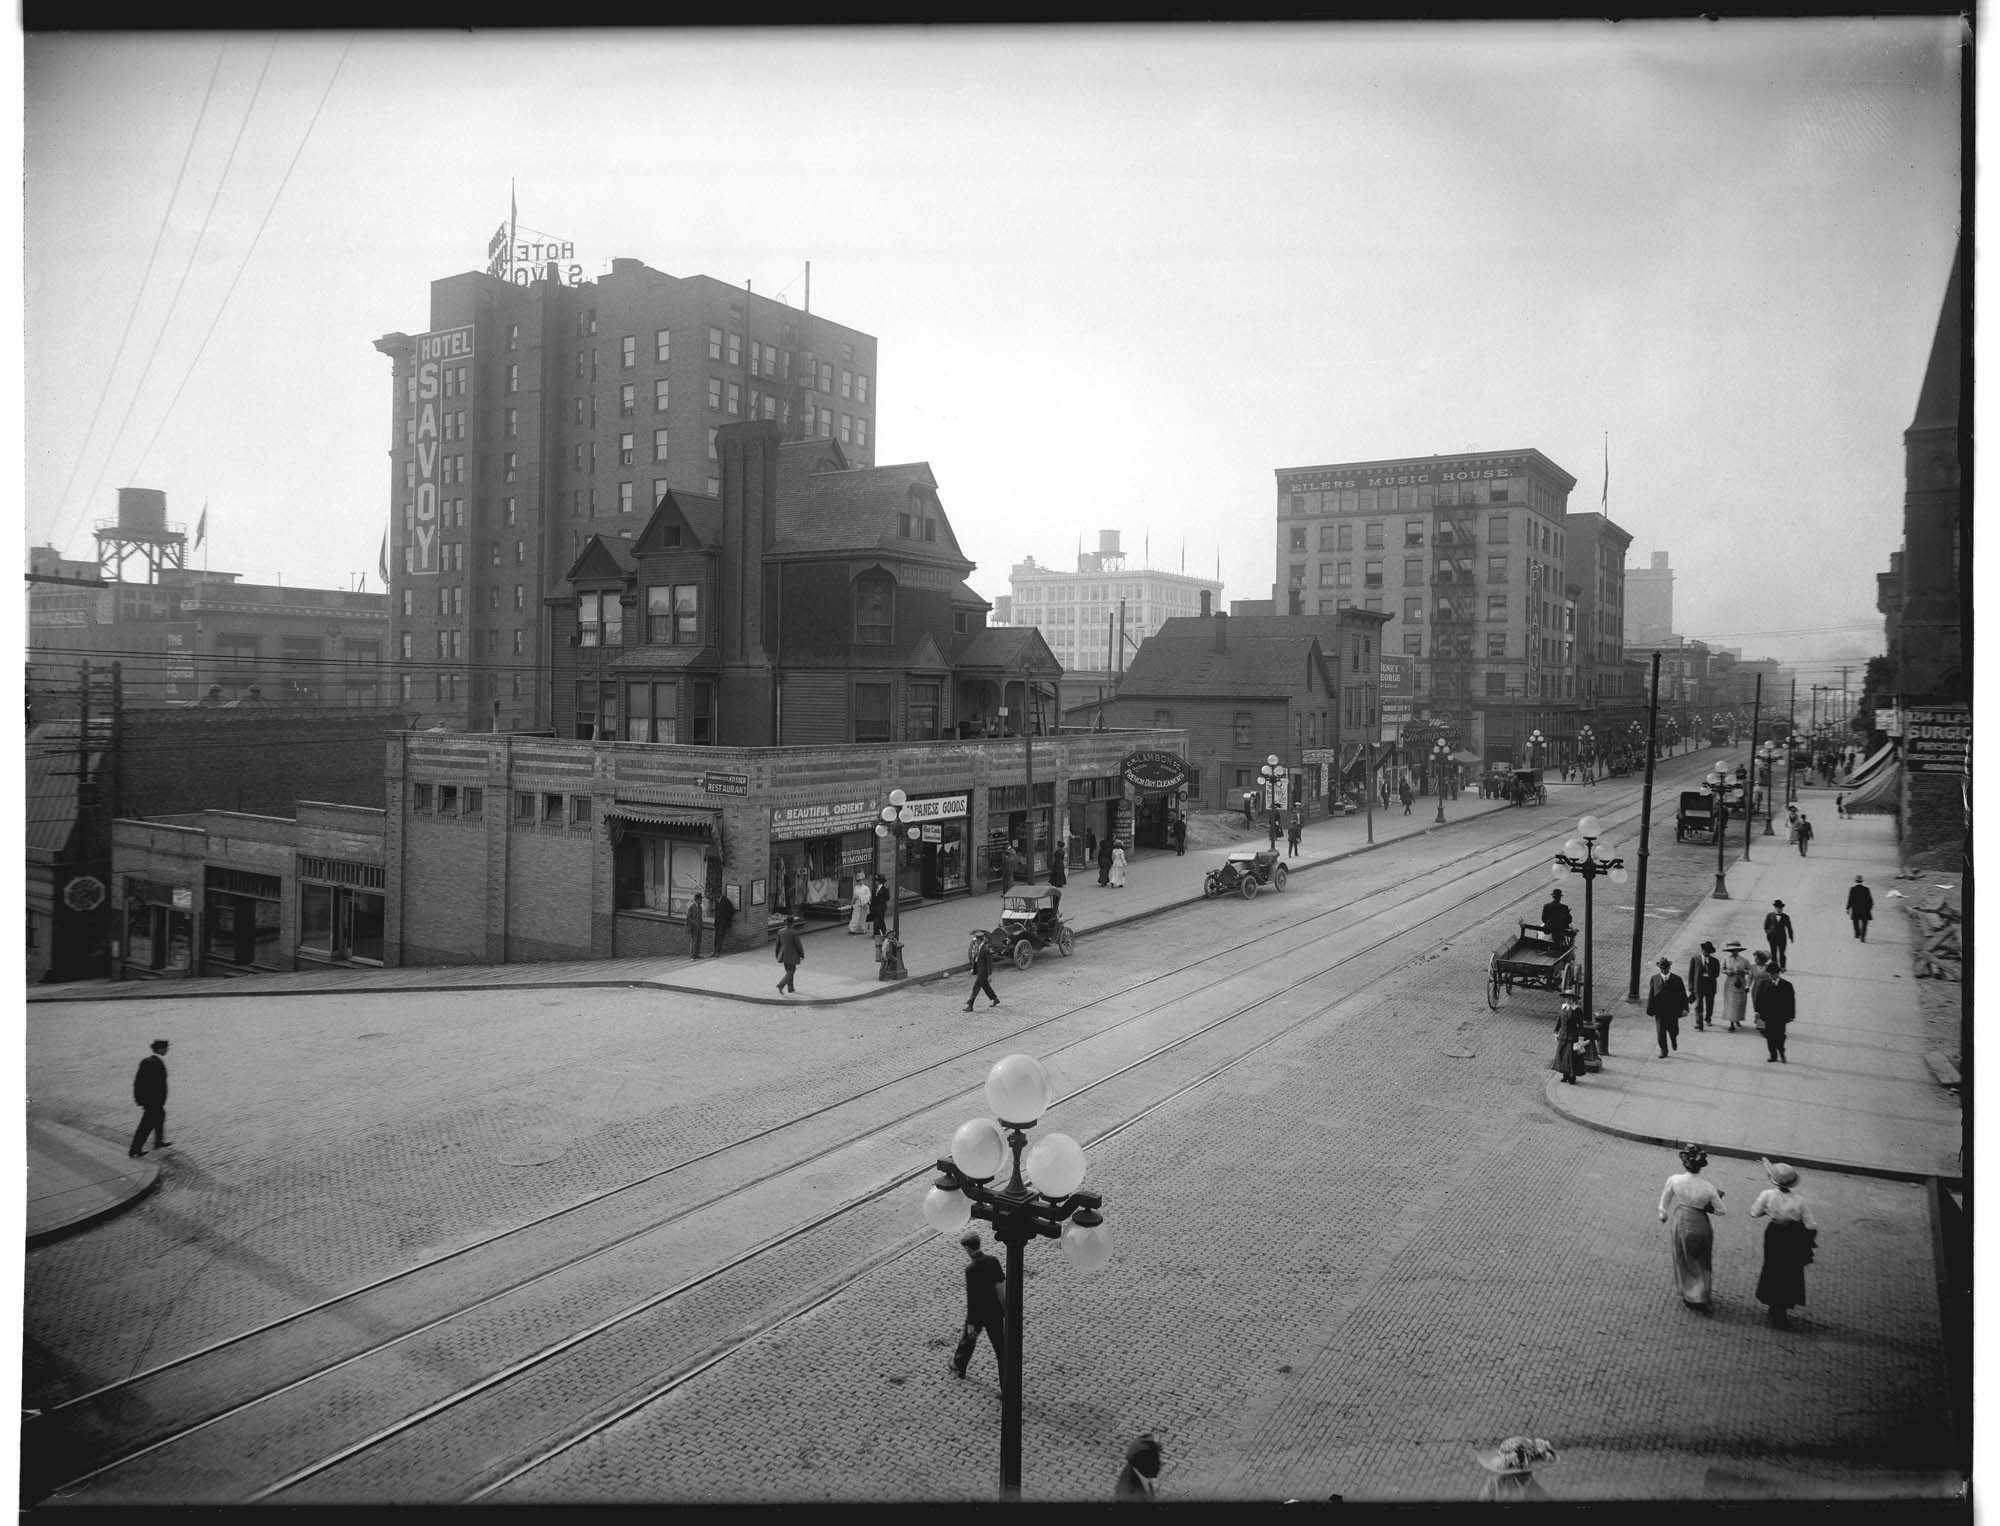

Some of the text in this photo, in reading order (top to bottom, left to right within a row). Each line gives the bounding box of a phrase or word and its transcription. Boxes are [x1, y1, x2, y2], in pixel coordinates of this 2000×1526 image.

[422, 331, 471, 361] HOTEL
[416, 362, 439, 570] SAVOY
[1291, 480, 1356, 493] EILERS
[1369, 473, 1430, 488] MUSIC
[1124, 769, 1145, 785] FRENCH
[707, 783, 747, 795] RESTAURANT
[786, 806, 830, 820] BEAUTIFUL
[833, 802, 865, 815] ORIENT
[906, 802, 940, 817] APANESE
